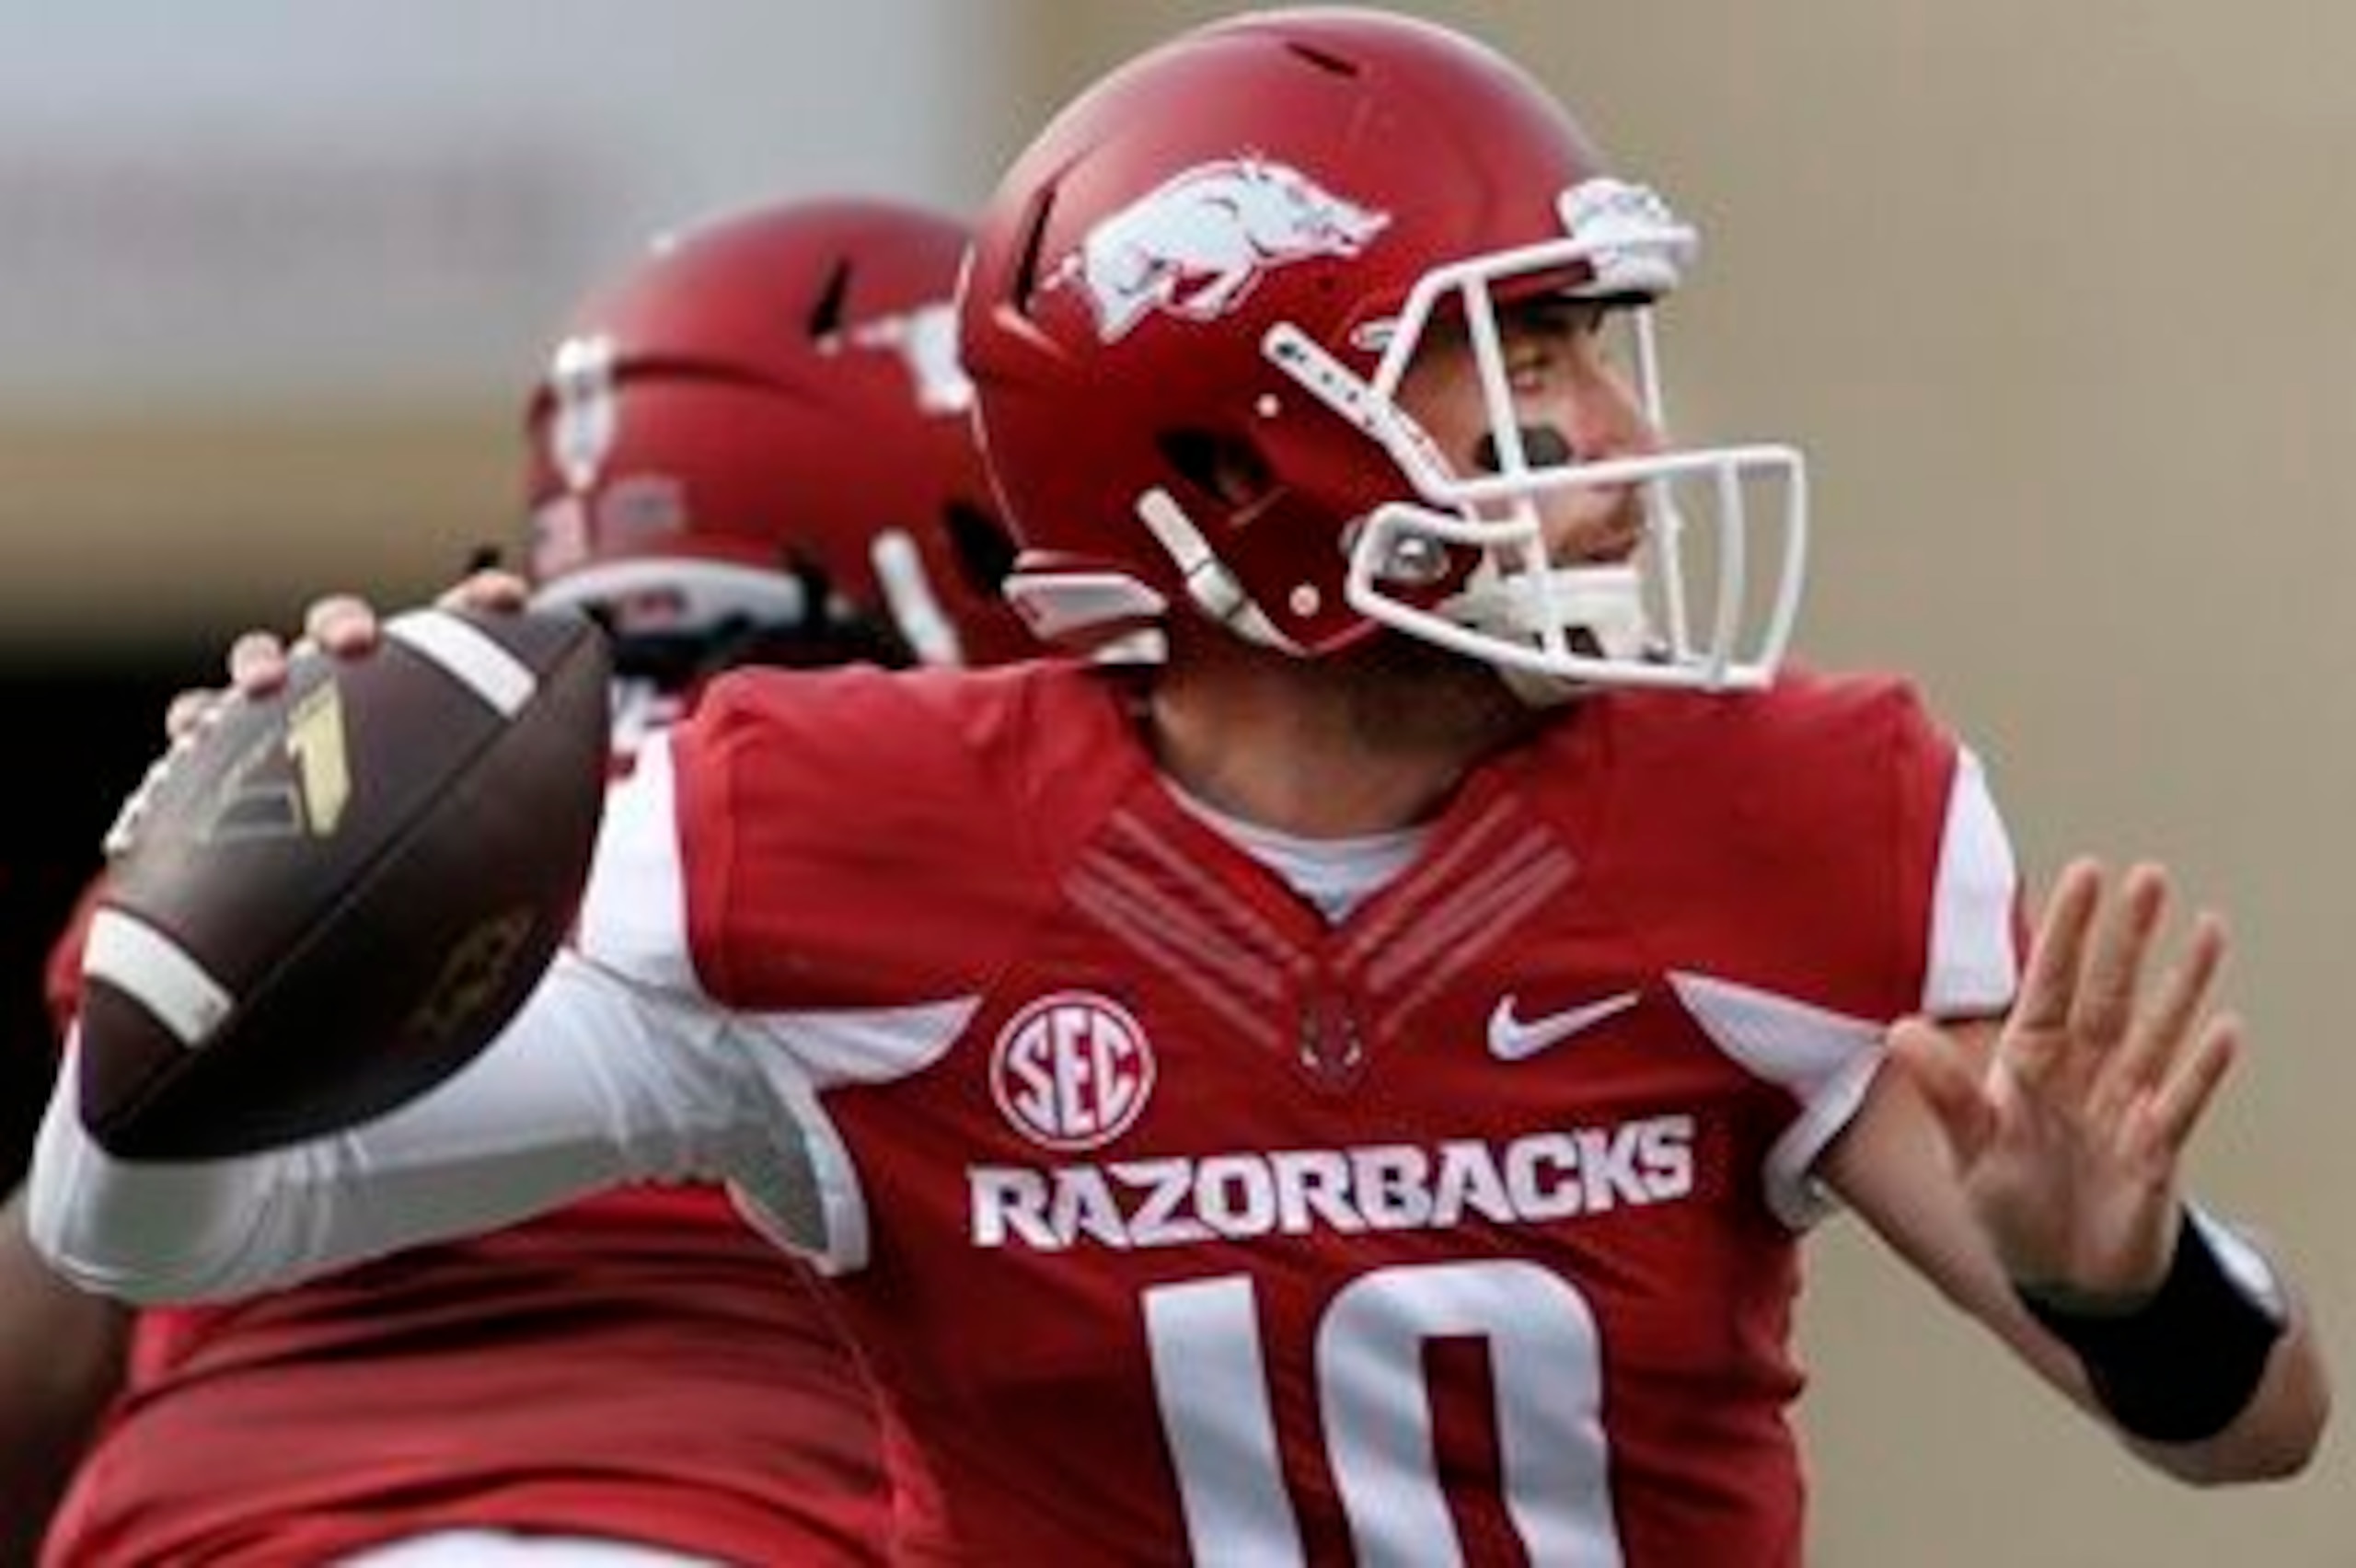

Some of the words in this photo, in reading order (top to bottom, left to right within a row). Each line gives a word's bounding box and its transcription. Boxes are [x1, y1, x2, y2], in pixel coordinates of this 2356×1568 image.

[1007, 1009, 1138, 1136] SEC
[969, 1114, 1695, 1249] RAZORBACKS
[1142, 1260, 1626, 1568] 10
